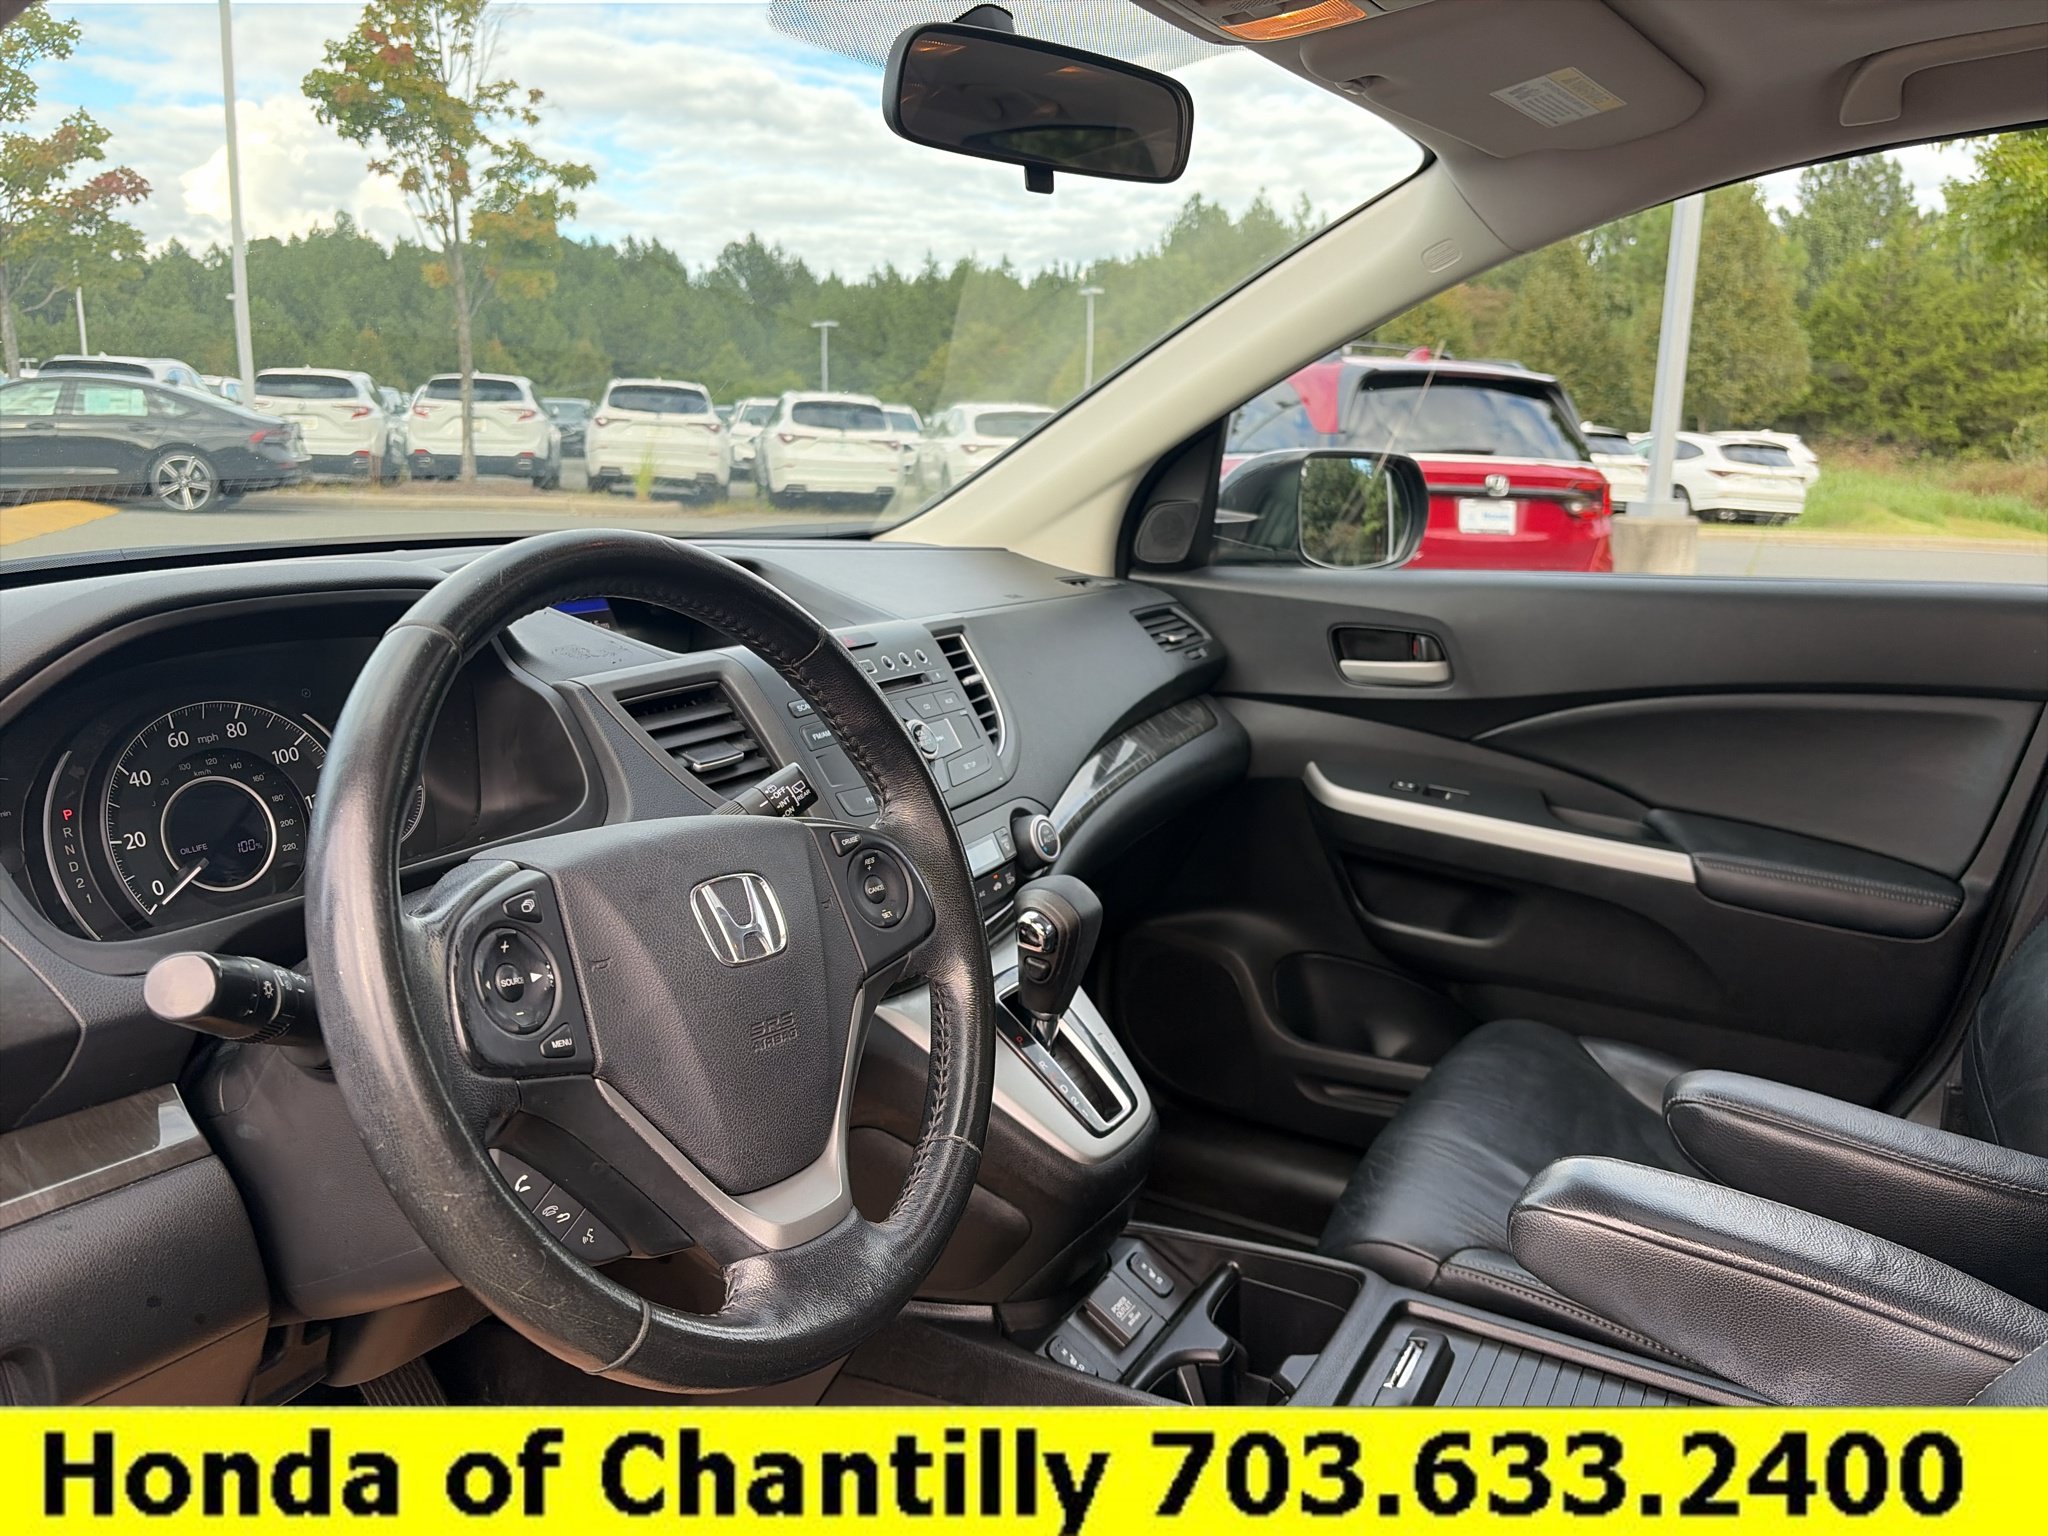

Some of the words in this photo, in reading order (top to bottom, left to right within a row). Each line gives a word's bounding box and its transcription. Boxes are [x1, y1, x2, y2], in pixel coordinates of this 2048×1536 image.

[226, 721, 248, 738] 80
[167, 730, 190, 749] 60
[197, 732, 219, 745] mph
[205, 757, 218, 766] 120
[271, 746, 300, 765] 100
[229, 762, 242, 770] 140
[128, 769, 152, 788] 40
[193, 768, 212, 777] km/h
[252, 774, 265, 783] 160
[271, 794, 284, 802] 180
[772, 785, 786, 799] OFF
[796, 789, 811, 801] REAR
[778, 795, 791, 808] INT
[62, 809, 73, 821] P
[784, 806, 796, 817] ON
[279, 819, 294, 828] 200
[62, 827, 74, 838] R
[123, 831, 147, 850] 20
[841, 834, 860, 846] CRUISE
[64, 844, 76, 856] N
[282, 842, 297, 852] 220
[68, 861, 79, 873] D
[864, 856, 875, 866] RES
[75, 877, 86, 889] 2
[151, 879, 165, 896] 0
[86, 893, 92, 904] 1
[500, 976, 525, 988] SOURCE
[751, 1011, 795, 1040] SRS
[551, 1037, 573, 1049] MENU
[751, 1029, 798, 1052] AIRBAG
